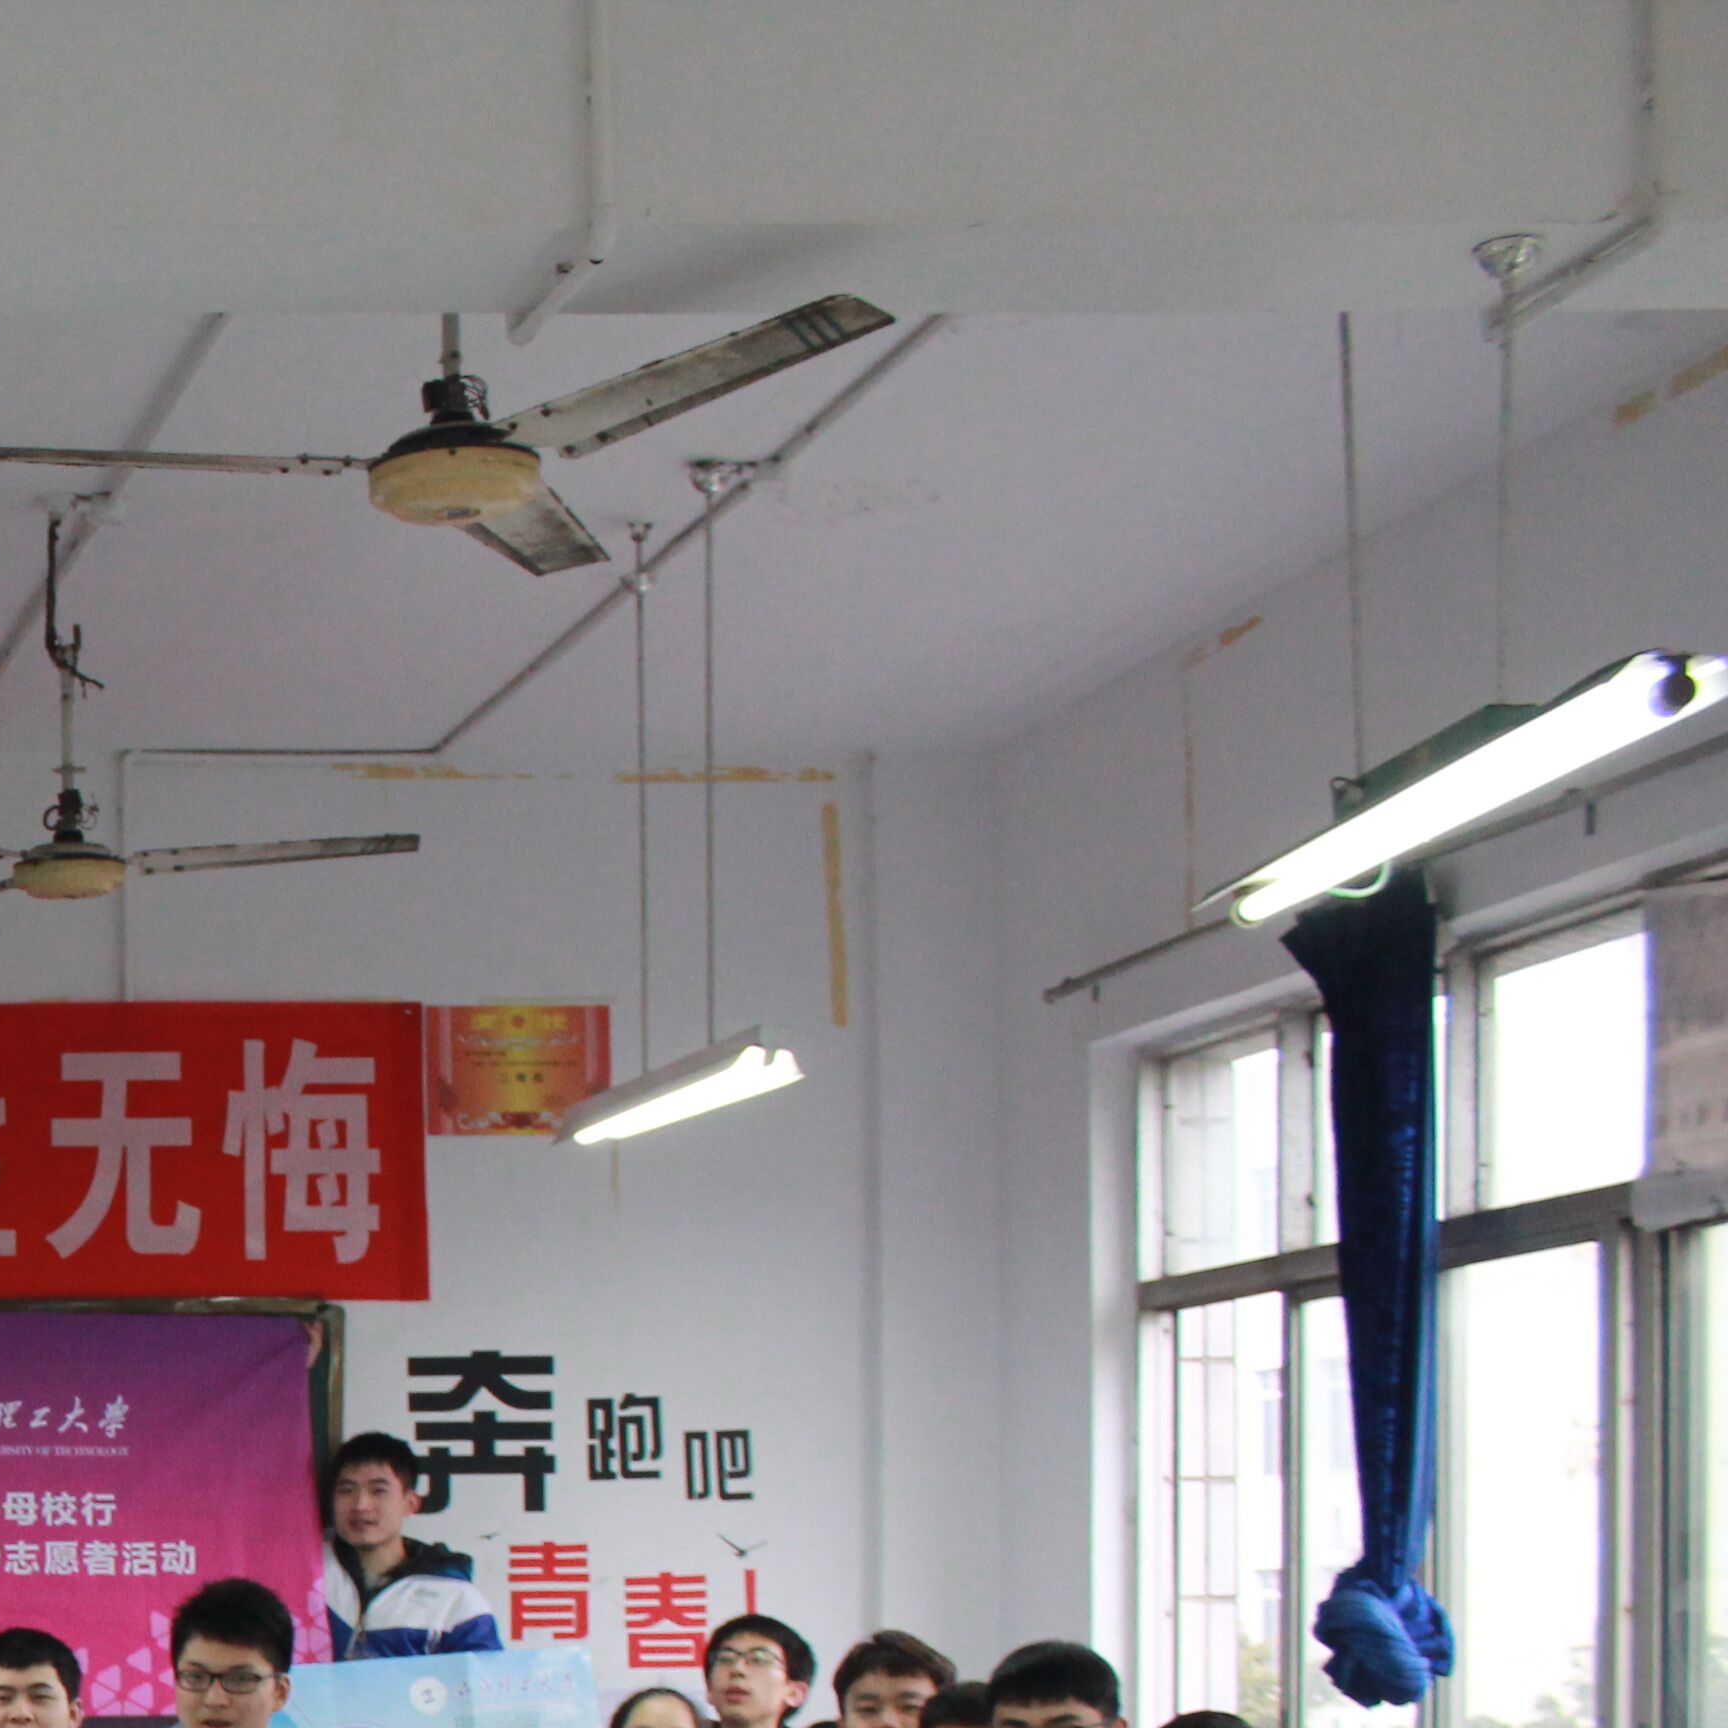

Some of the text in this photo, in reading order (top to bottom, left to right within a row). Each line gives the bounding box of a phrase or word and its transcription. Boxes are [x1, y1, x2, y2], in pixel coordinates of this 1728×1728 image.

[35, 1445, 52, 1457] OF
[54, 1445, 130, 1457] TECHNOLOGY
[406, 1349, 754, 1514] 奔跑吧
